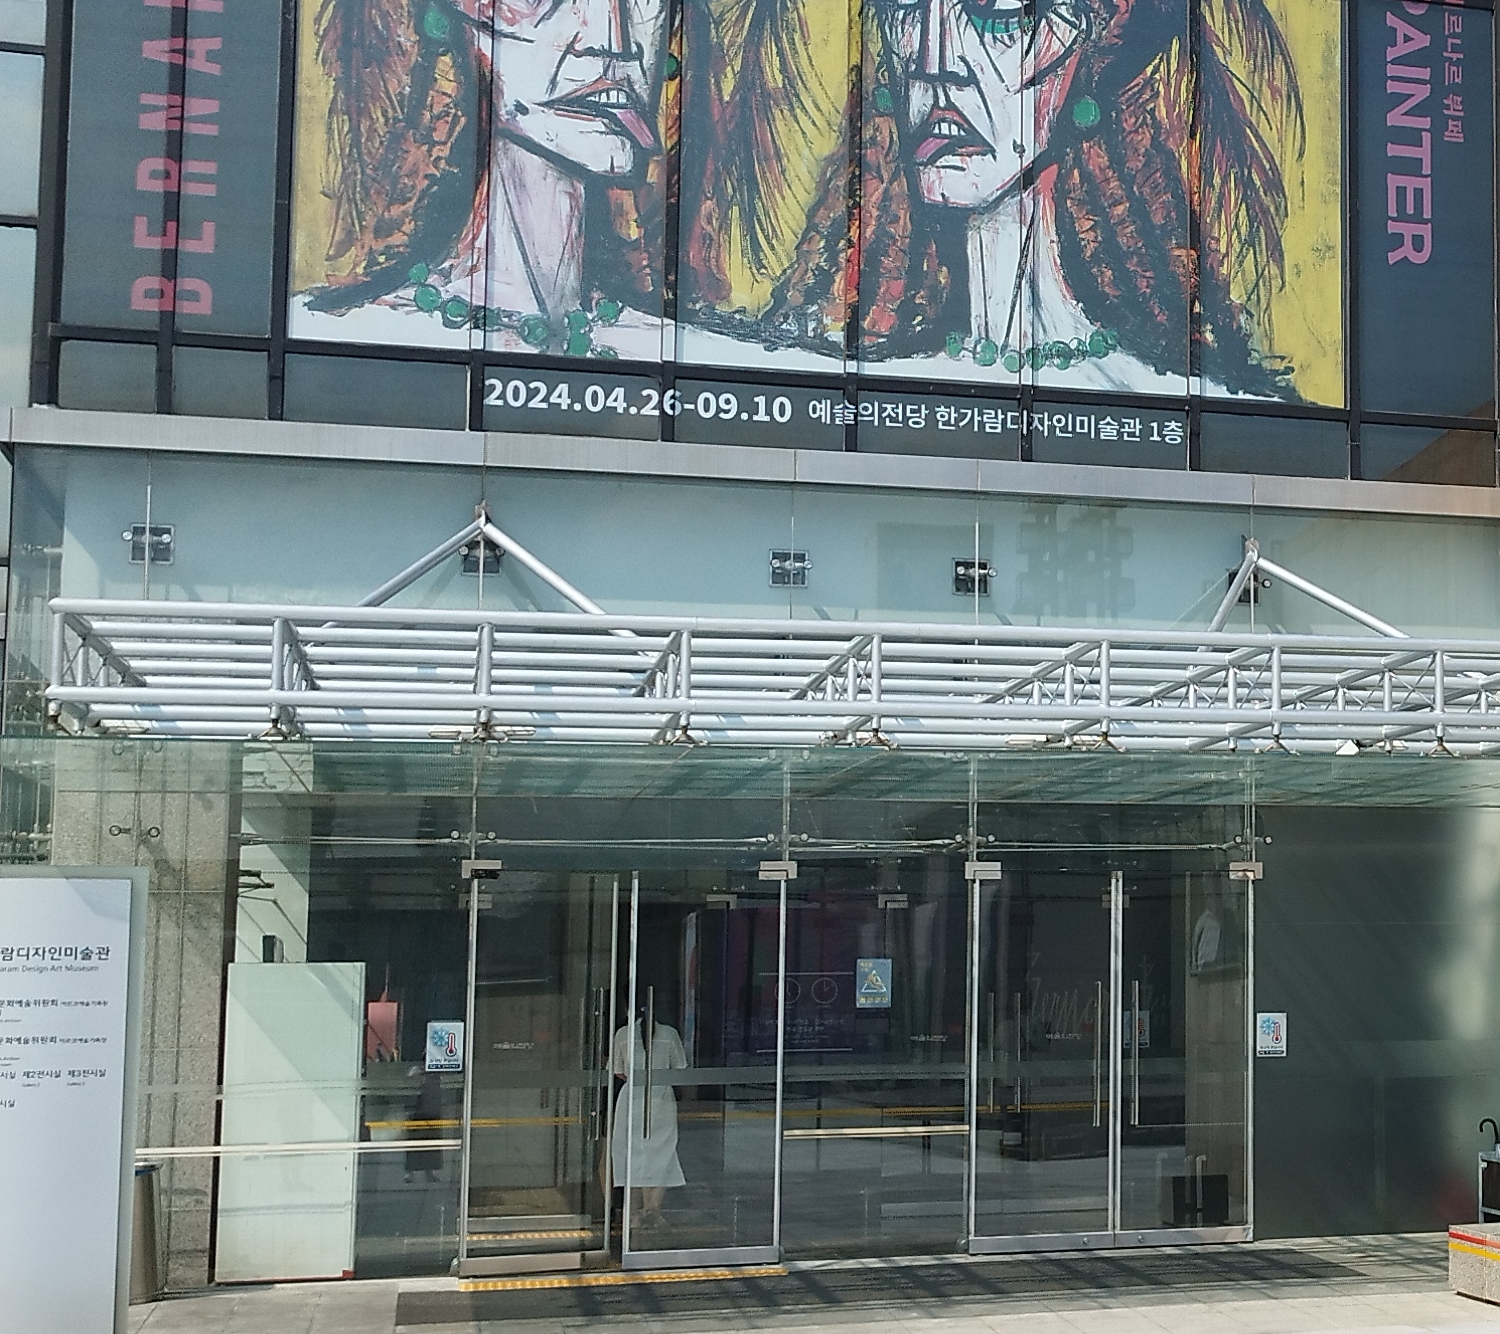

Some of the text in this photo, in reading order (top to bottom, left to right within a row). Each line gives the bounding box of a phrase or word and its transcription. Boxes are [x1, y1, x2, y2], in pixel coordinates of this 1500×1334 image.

[1442, 92, 1465, 144] 뷔페
[483, 379, 1186, 446] 2024.04.26-09.10 예술의전당 한가람디자인미술관 1층
[1, 945, 111, 962] 람디자인미술관
